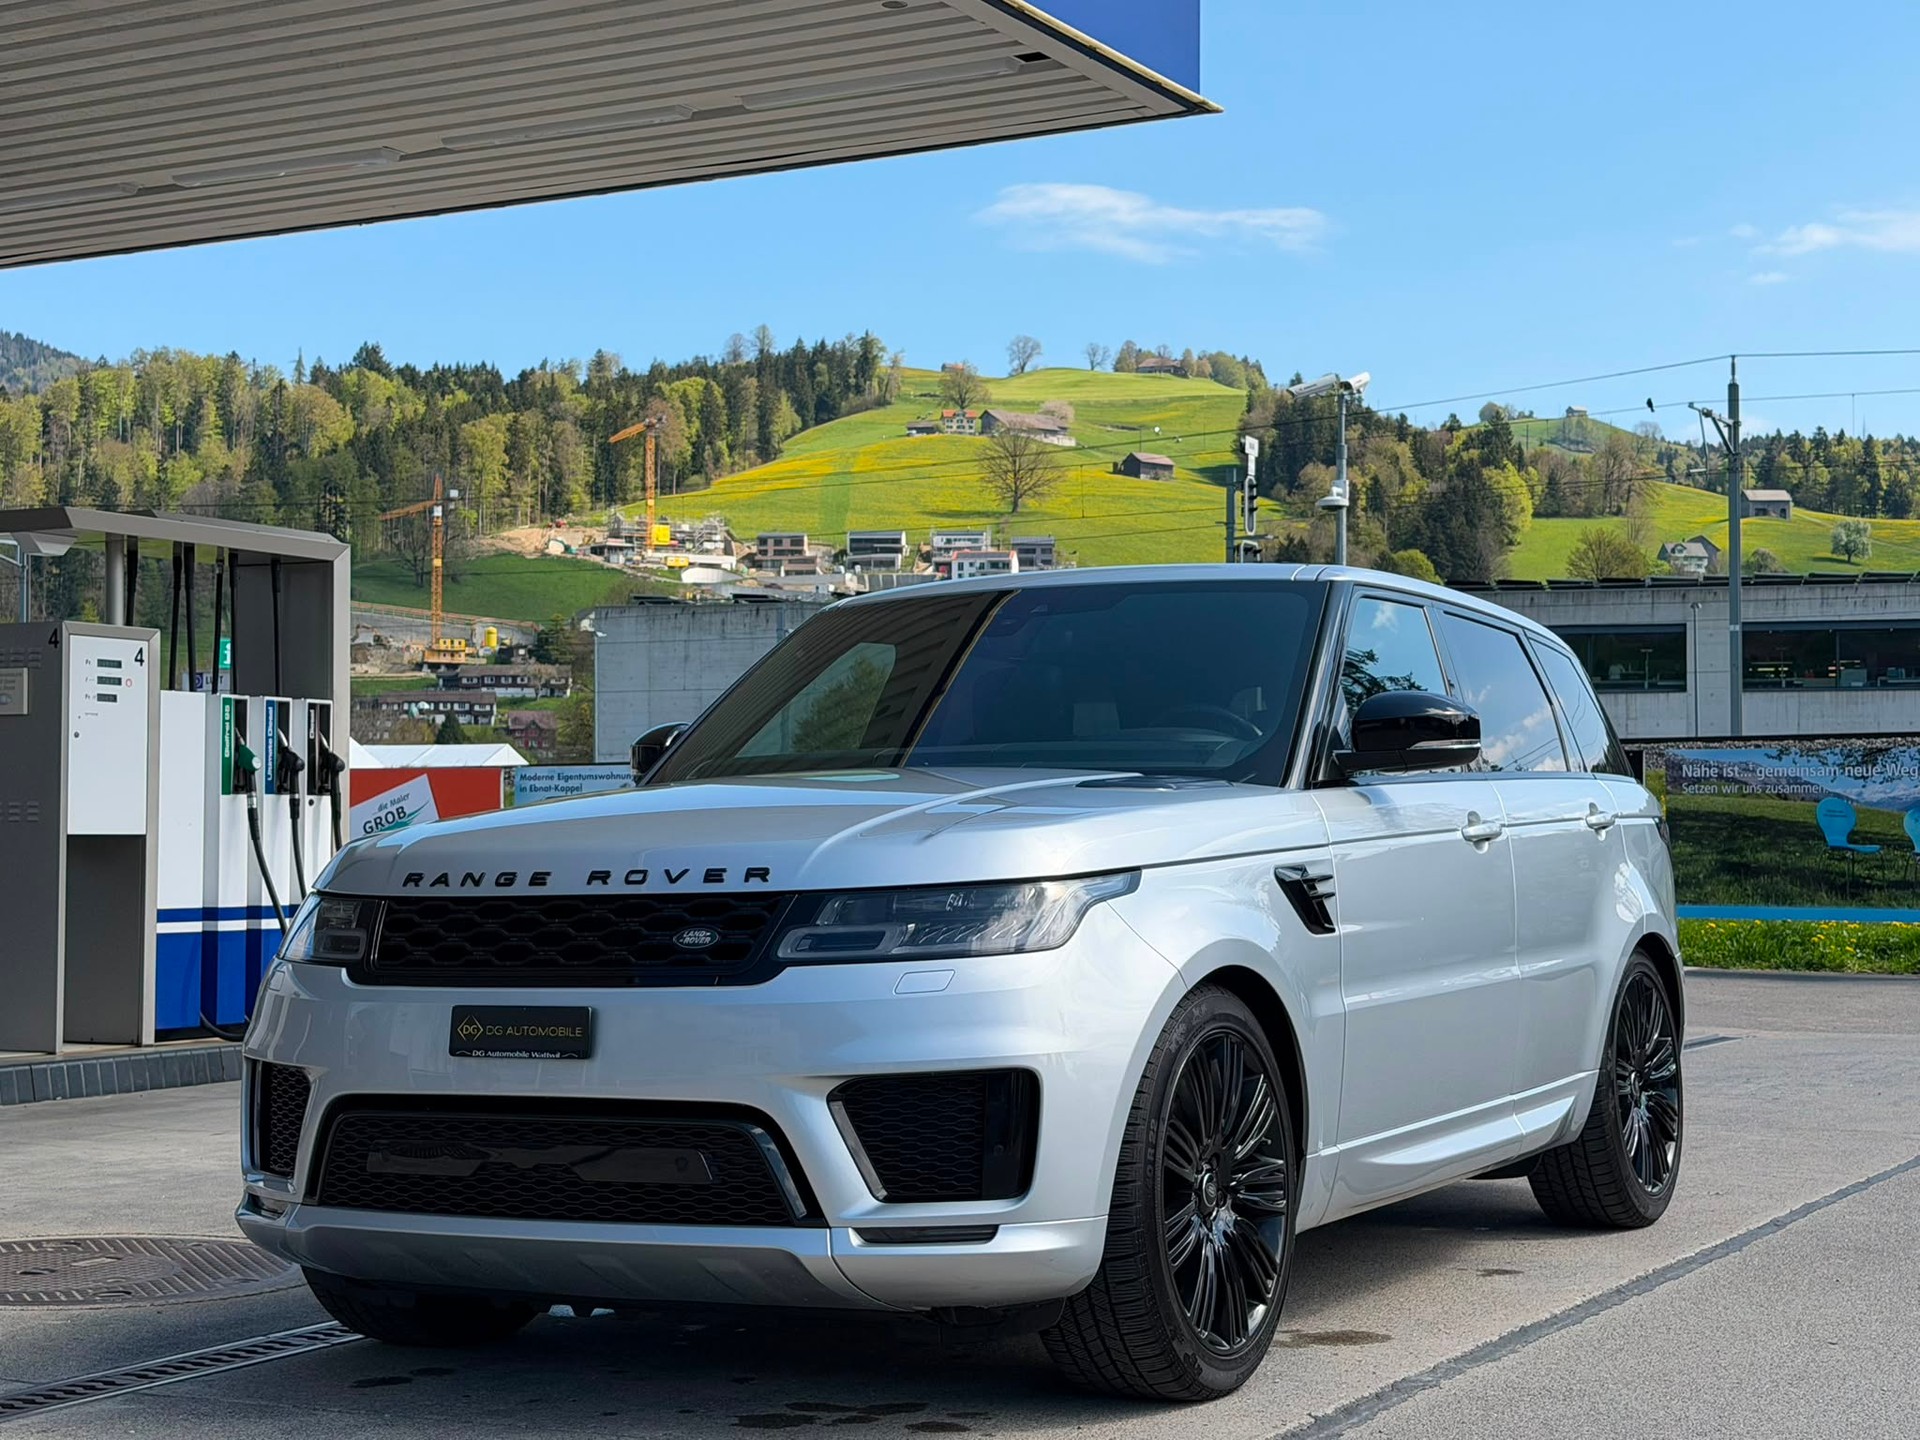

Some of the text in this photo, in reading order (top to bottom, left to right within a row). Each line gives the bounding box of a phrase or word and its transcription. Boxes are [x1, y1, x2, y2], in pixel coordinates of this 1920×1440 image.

[48, 628, 59, 648] 4
[134, 647, 145, 666] 4
[519, 772, 555, 781] Moderne
[1682, 763, 1718, 778] Nähe
[1756, 764, 1839, 780] gemeinsam
[1844, 765, 1881, 778] neue
[519, 784, 527, 793] in
[1682, 782, 1829, 794] Setzen wir uns zusammen.
[389, 793, 410, 807] Maler
[363, 806, 407, 834] GROB
[402, 867, 771, 887] RANGE ROVER
[683, 930, 706, 938] LAND
[463, 1024, 478, 1035] DG
[486, 1025, 584, 1037] DG AUTOMOBILE
[486, 1050, 530, 1058] Automobile
